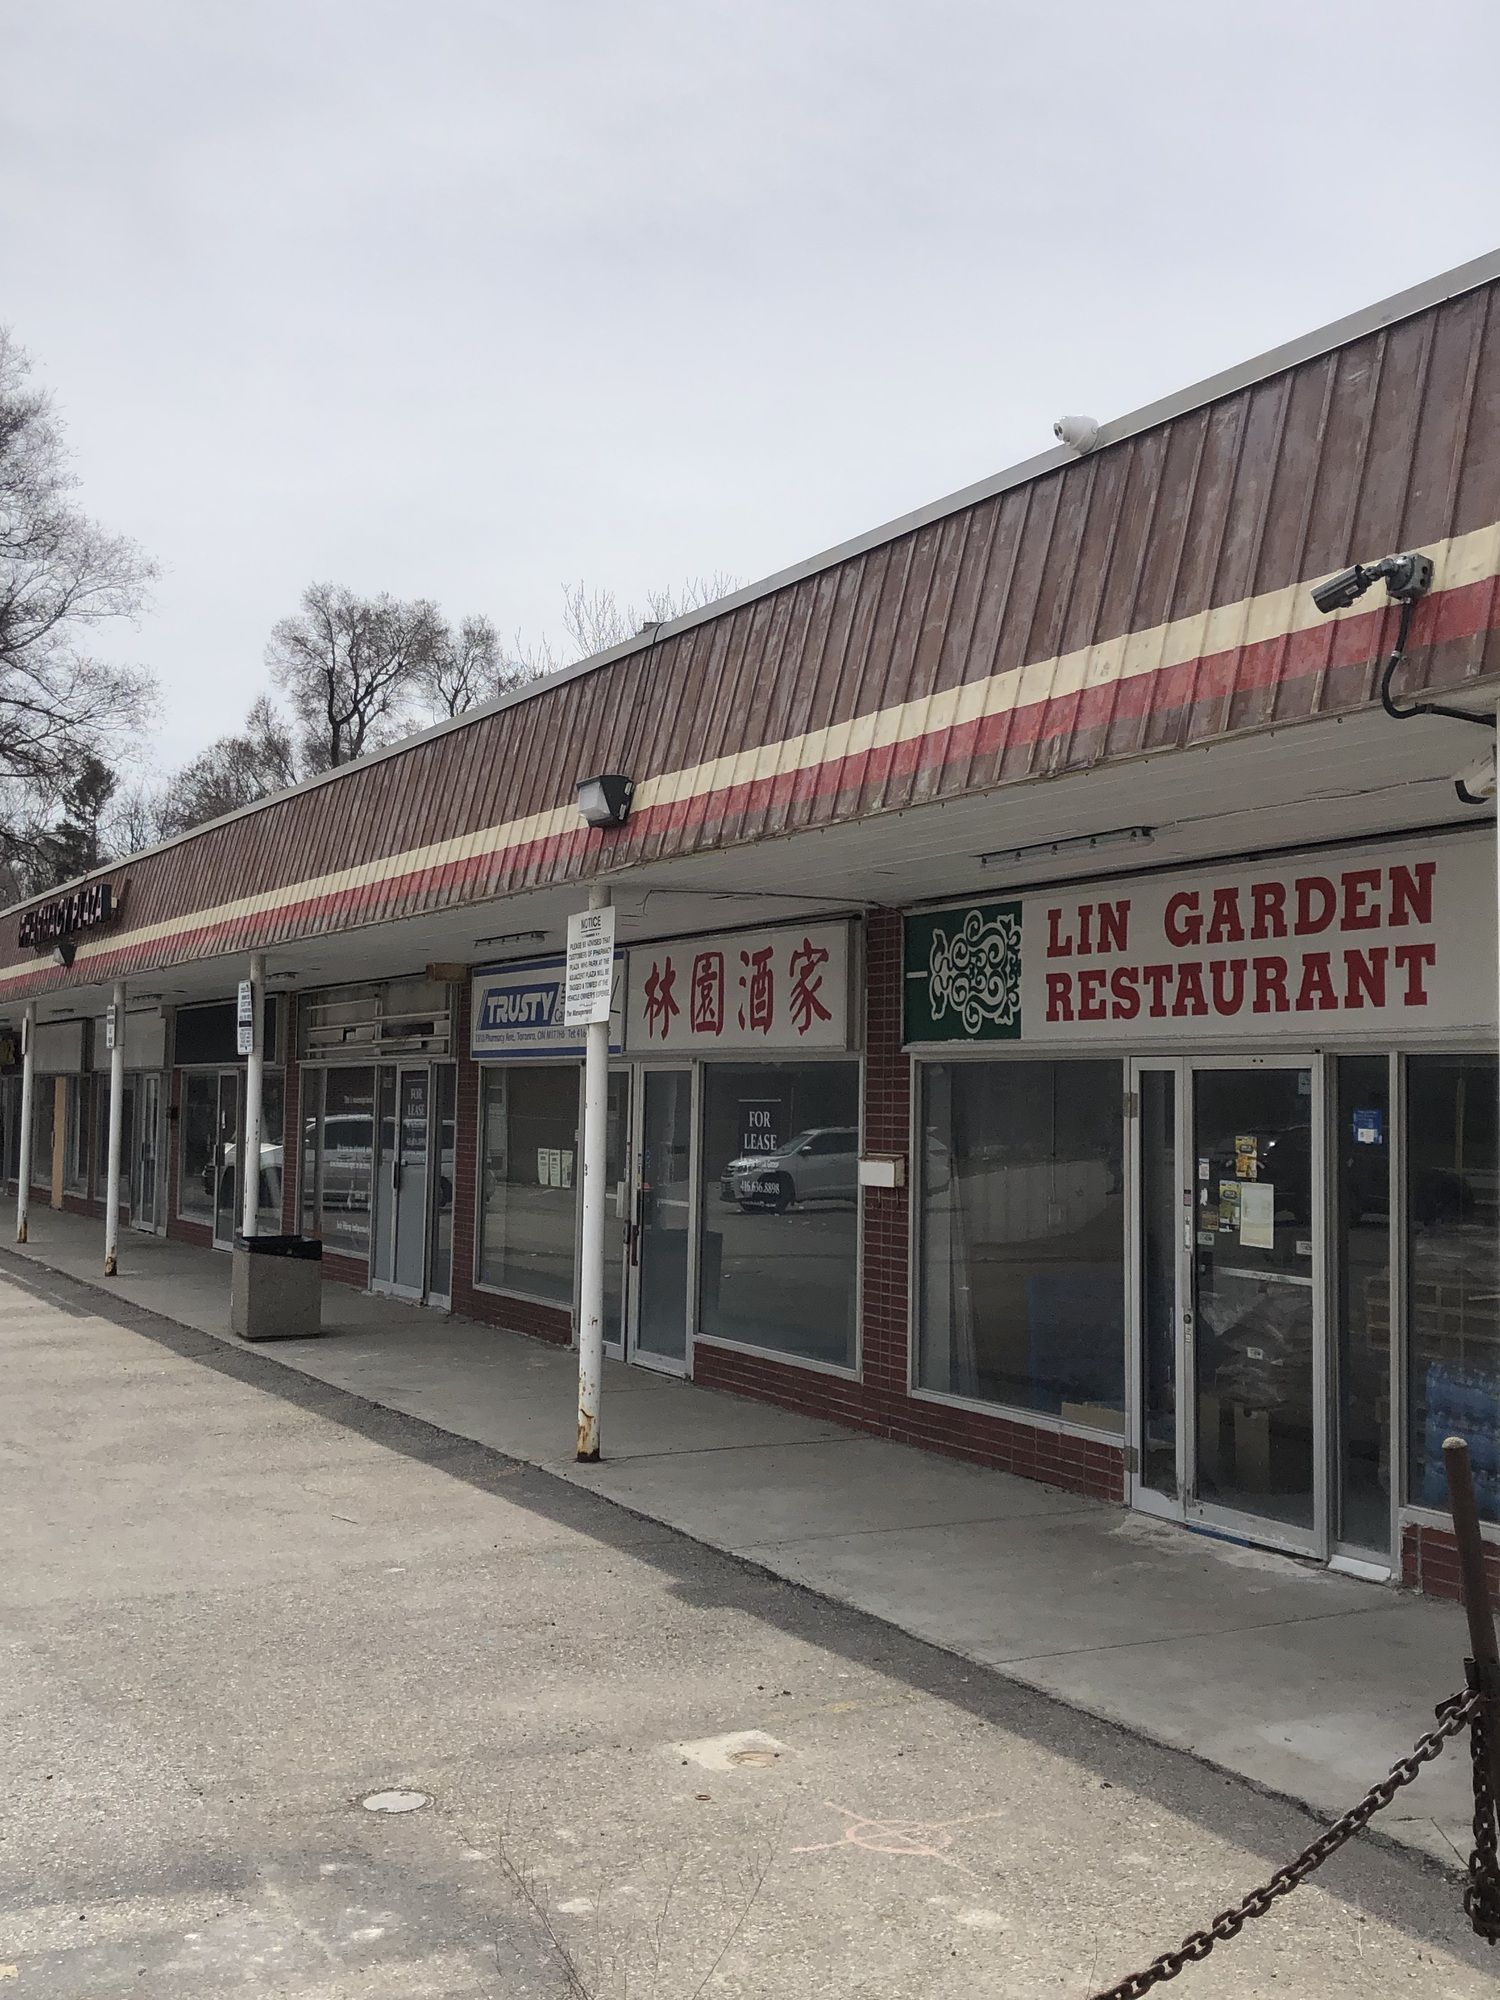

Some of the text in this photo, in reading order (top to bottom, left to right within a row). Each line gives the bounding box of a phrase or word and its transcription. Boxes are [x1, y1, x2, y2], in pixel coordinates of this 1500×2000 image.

[1046, 861, 1437, 958] LIN GARDEN
[580, 916, 601, 929] NOTICE
[643, 937, 832, 1041] 林園酒家
[1045, 943, 1437, 1023] RESTAURANT
[487, 991, 555, 1024] TRUSTY
[410, 1087, 423, 1100] FOR
[407, 1103, 425, 1116] LEASE
[749, 1110, 771, 1128] FOR
[744, 1133, 777, 1150] LEASE
